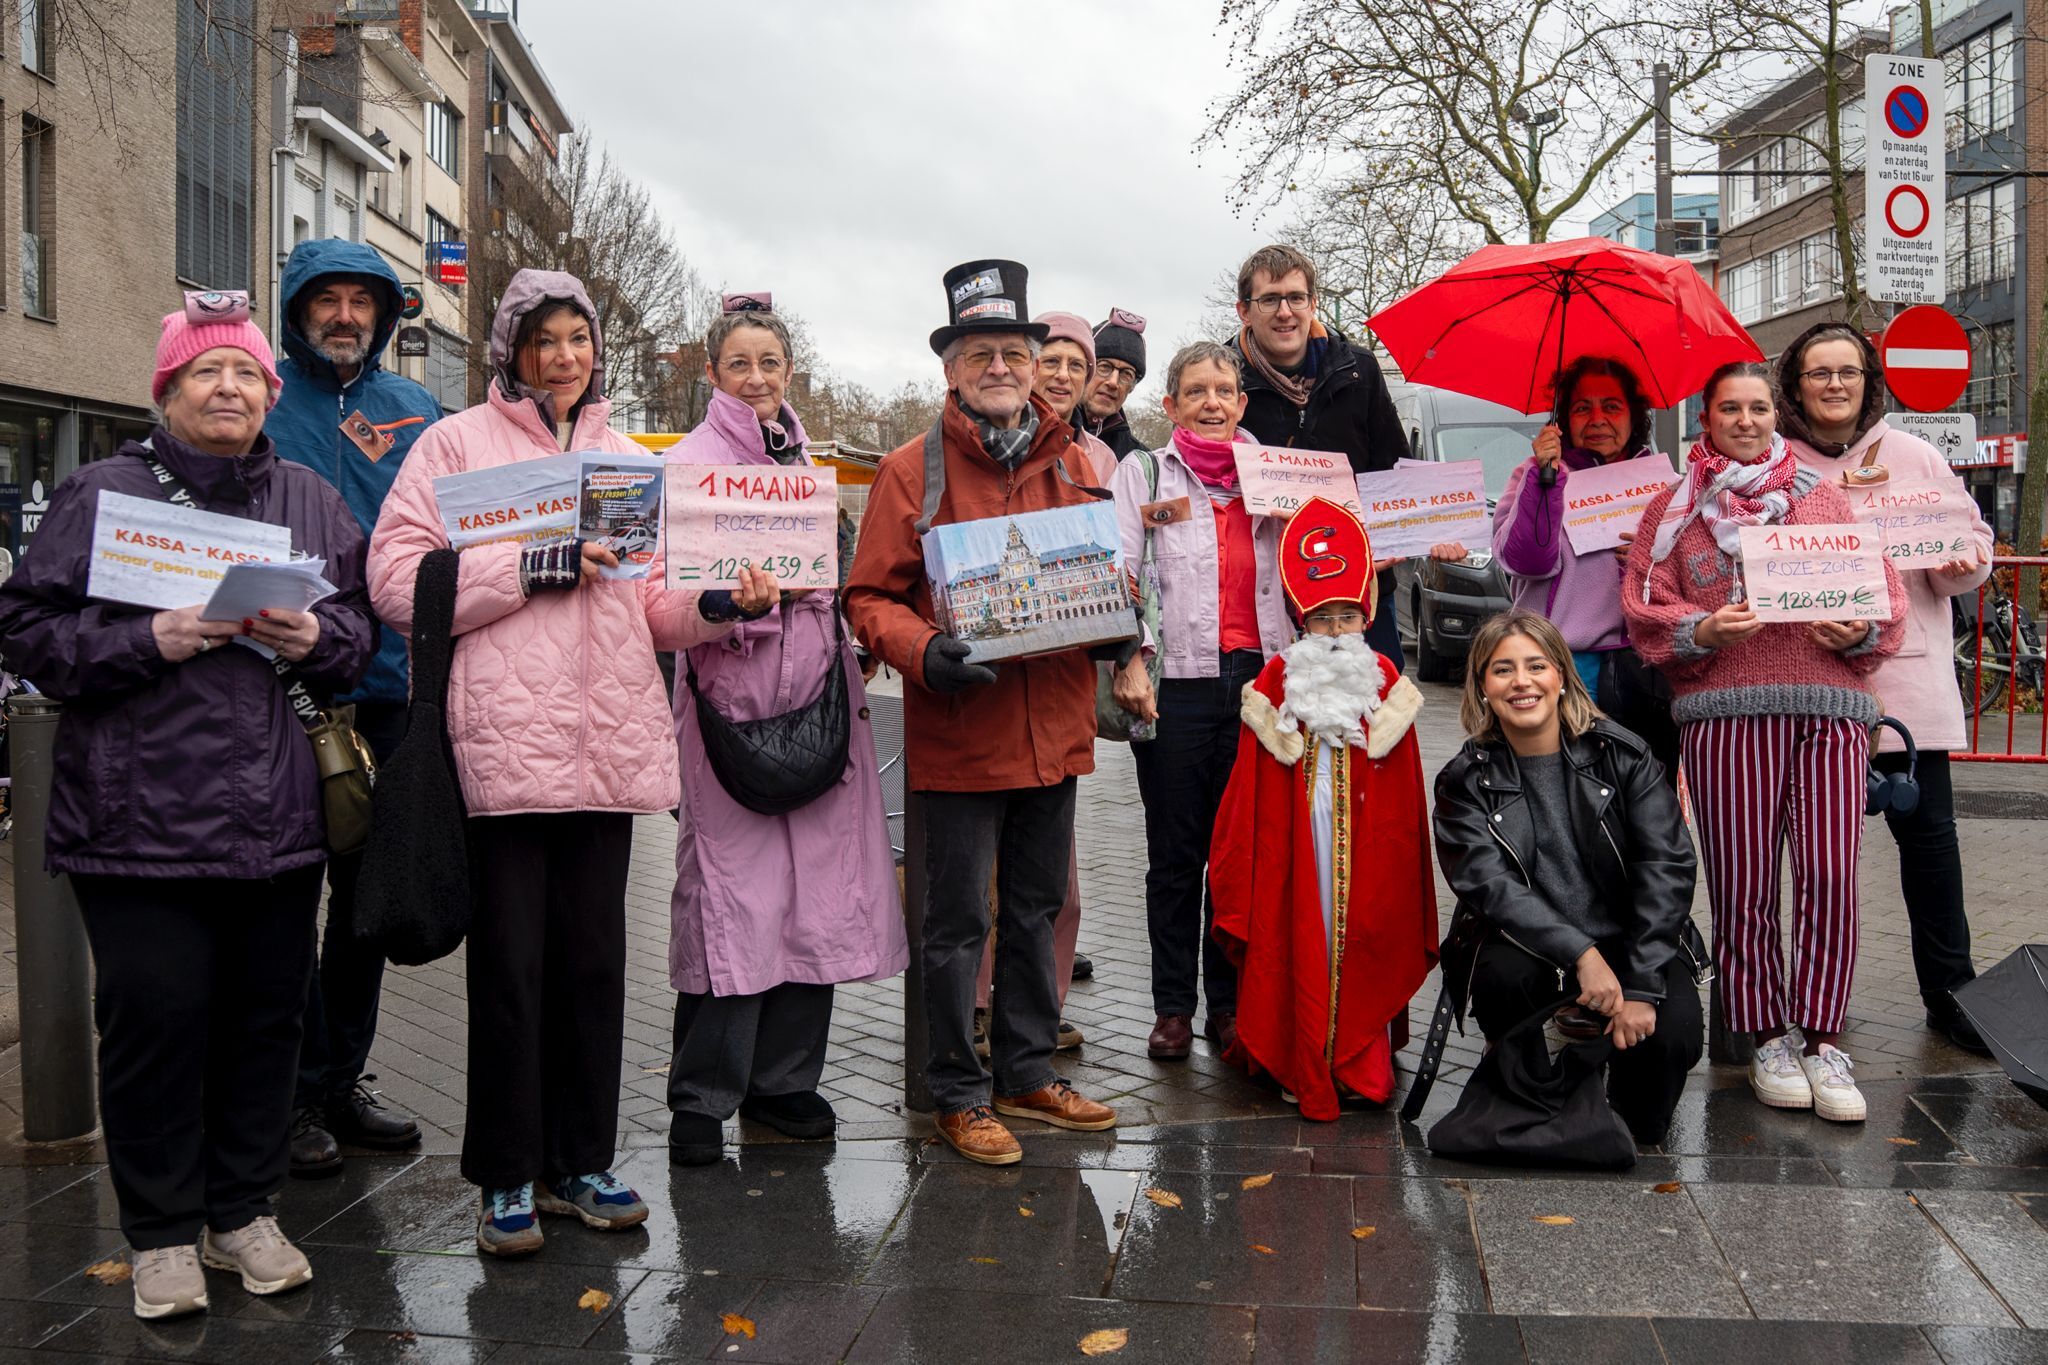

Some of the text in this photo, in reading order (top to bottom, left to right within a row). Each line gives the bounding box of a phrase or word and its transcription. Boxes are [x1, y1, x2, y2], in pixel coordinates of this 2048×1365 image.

[1889, 62, 1925, 78] ZONE
[1882, 139, 1928, 155] Op maandag
[1884, 156, 1928, 170] en zaterdag
[1879, 169, 1934, 182] van 5 tot 16 uur
[1882, 237, 1933, 251] Uitgezonderd
[1876, 251, 1939, 265] marktvoertuigen
[1879, 266, 1934, 279] op maandag en
[1891, 278, 1925, 292] zaterdag
[1880, 290, 1936, 303] van 5 tot 16 uur
[1902, 416, 1961, 424] UITGEZONDERD
[1259, 451, 1334, 469] 1 MAAND
[1946, 447, 1953, 456] P
[1261, 468, 1334, 486] ROZE ZONE
[698, 472, 817, 501] 1 MAAND
[1372, 498, 1417, 513] KASSA
[1430, 491, 1476, 506] KASSA
[1568, 493, 1614, 510] KASSA
[1624, 481, 1668, 498] KASSA
[1863, 491, 1942, 508] 1 MAAND
[458, 507, 520, 531] KASSA
[714, 513, 818, 533] ROZE ZONE
[1398, 517, 1426, 528] geen
[1427, 508, 1484, 522] alternatief
[1568, 515, 1597, 527] maar
[1598, 511, 1626, 523] geen
[1870, 512, 1948, 529] ROZE ZONE
[115, 528, 186, 554] KASSA
[1765, 531, 1861, 552] 1 MAAND
[103, 550, 149, 568] maar
[152, 559, 194, 576] geen
[811, 553, 829, 575] €
[1766, 557, 1866, 577] ROZE ZONE
[1777, 589, 1847, 610] 128.439
[1850, 585, 1876, 605] €
